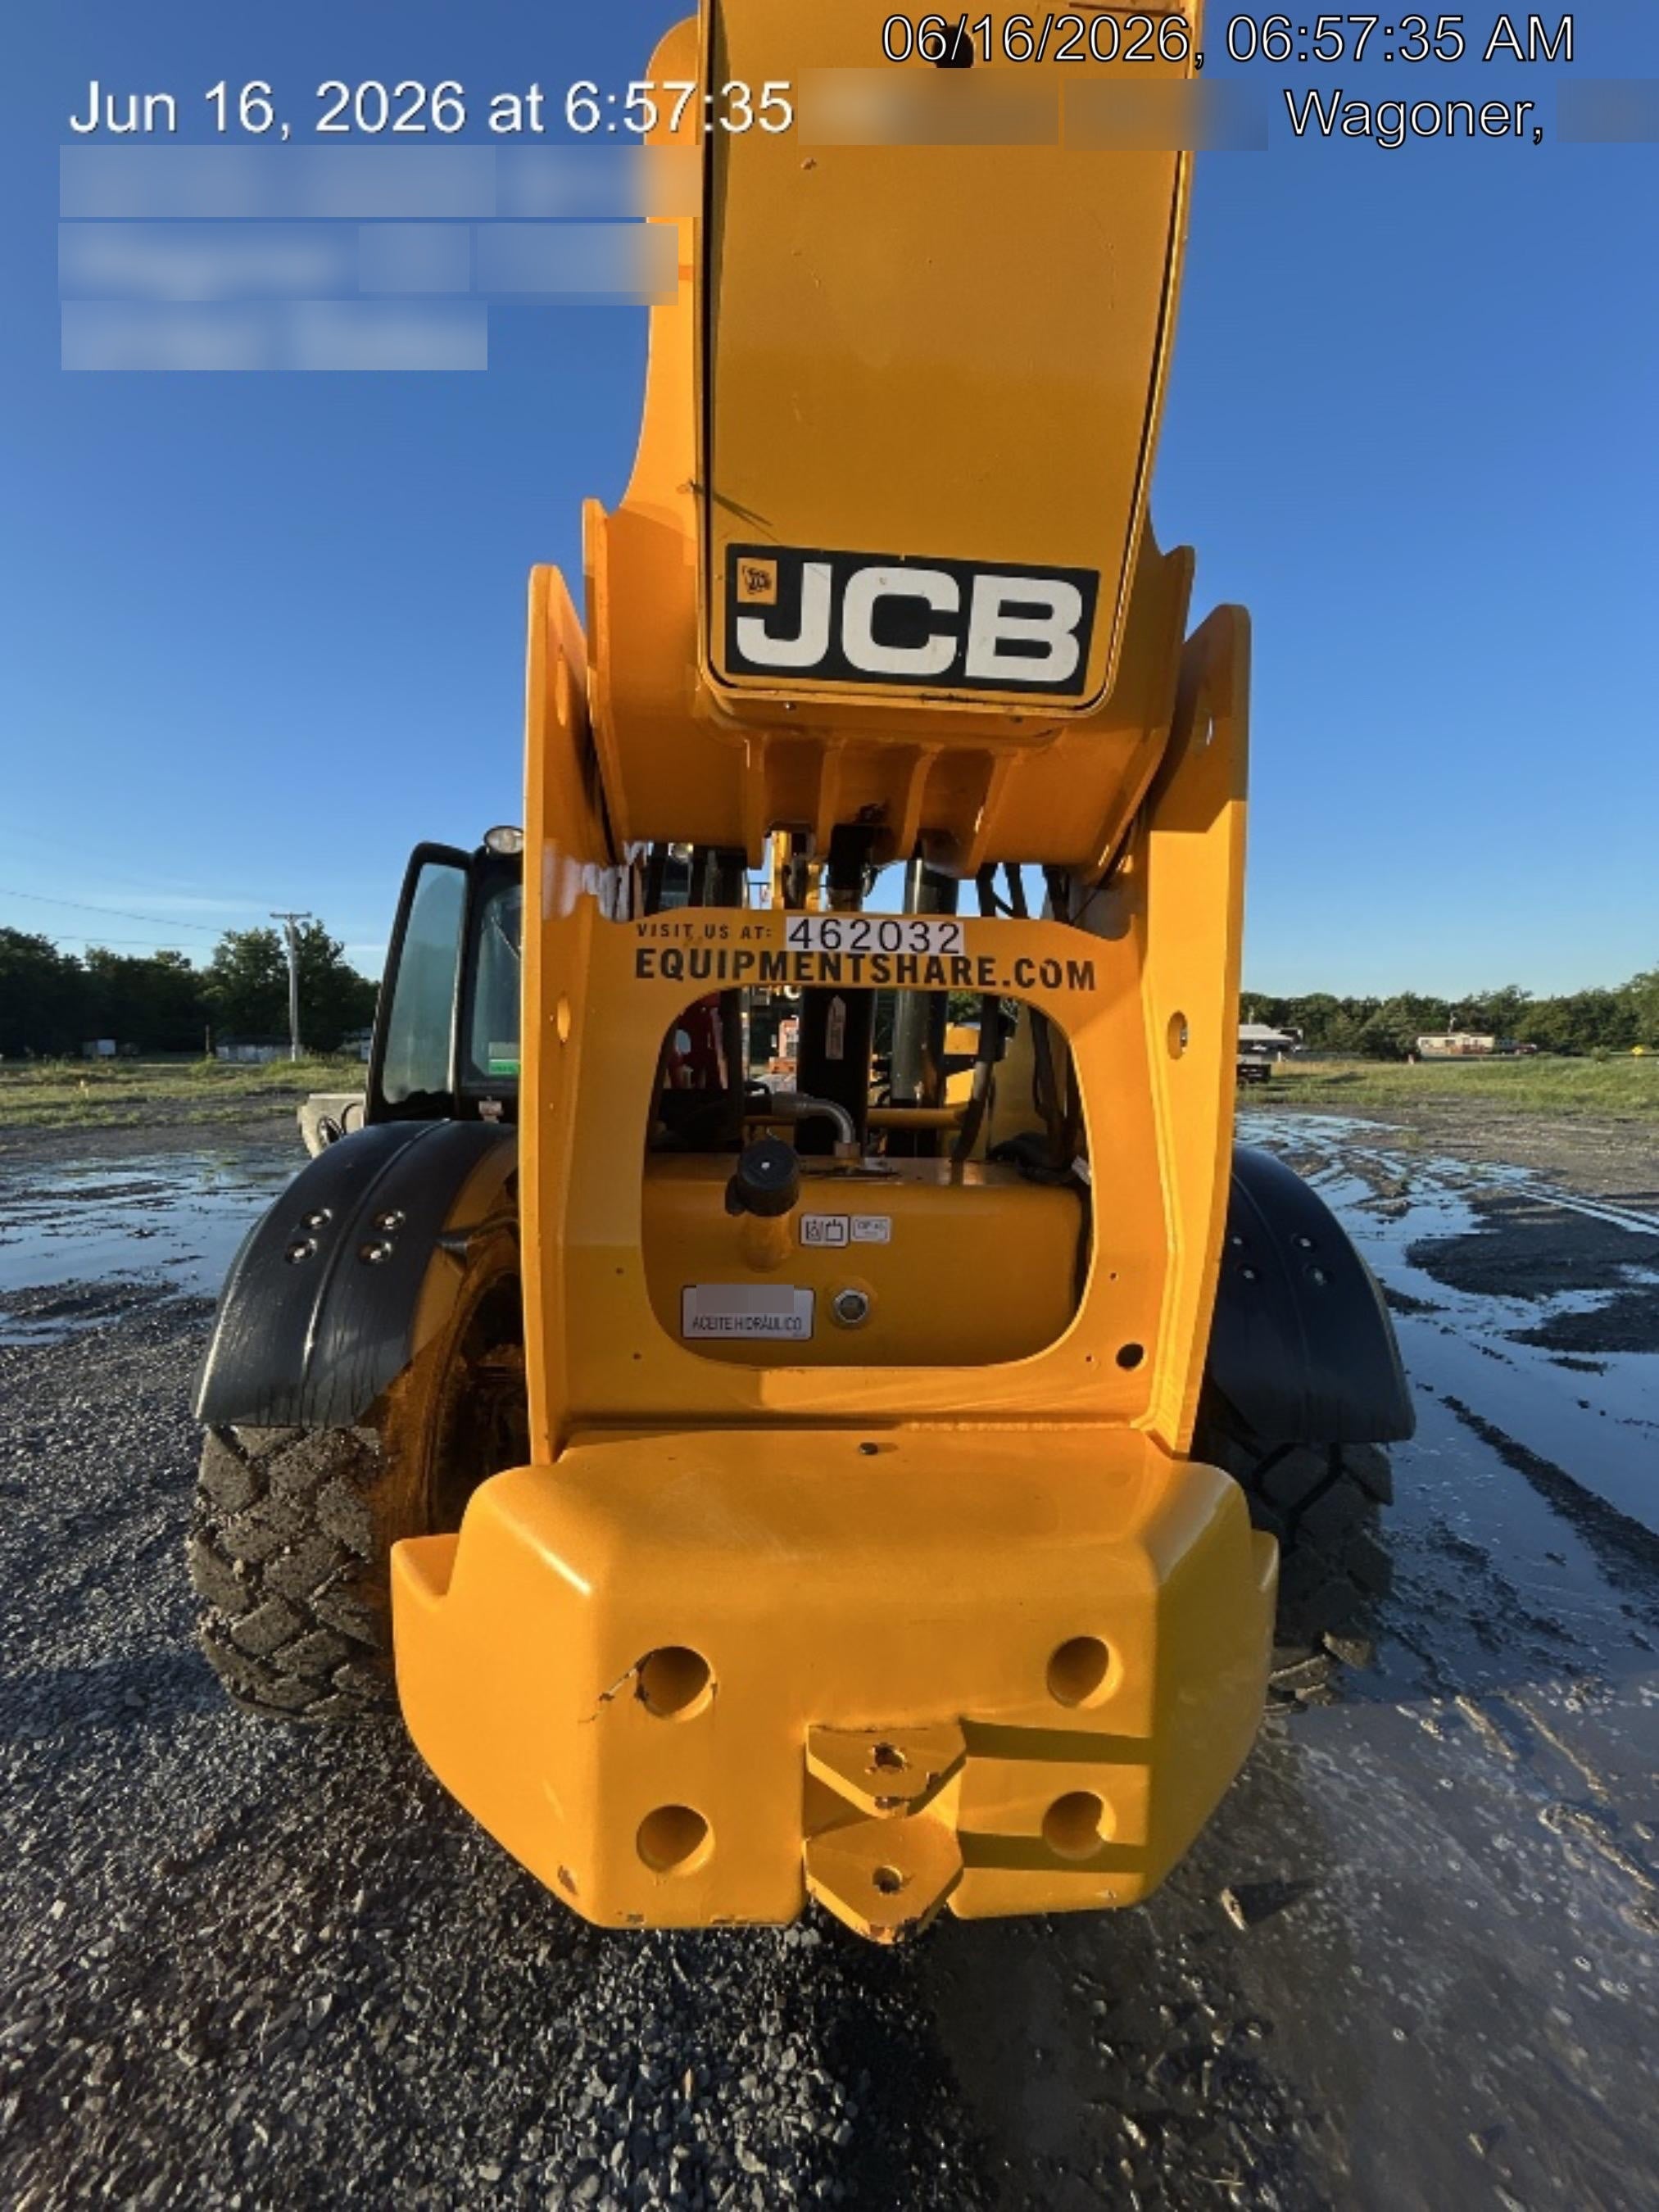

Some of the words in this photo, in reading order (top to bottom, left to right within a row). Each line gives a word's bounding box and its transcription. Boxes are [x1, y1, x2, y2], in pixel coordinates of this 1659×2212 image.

[737, 562, 1083, 682] JCB
[637, 924, 694, 937] VISIT
[705, 924, 729, 939] US
[741, 926, 772, 940] AT:
[788, 918, 960, 954] 462032
[635, 948, 1095, 991] EQUIPMENTSHARE.COM
[692, 1316, 732, 1330] ACEITE
